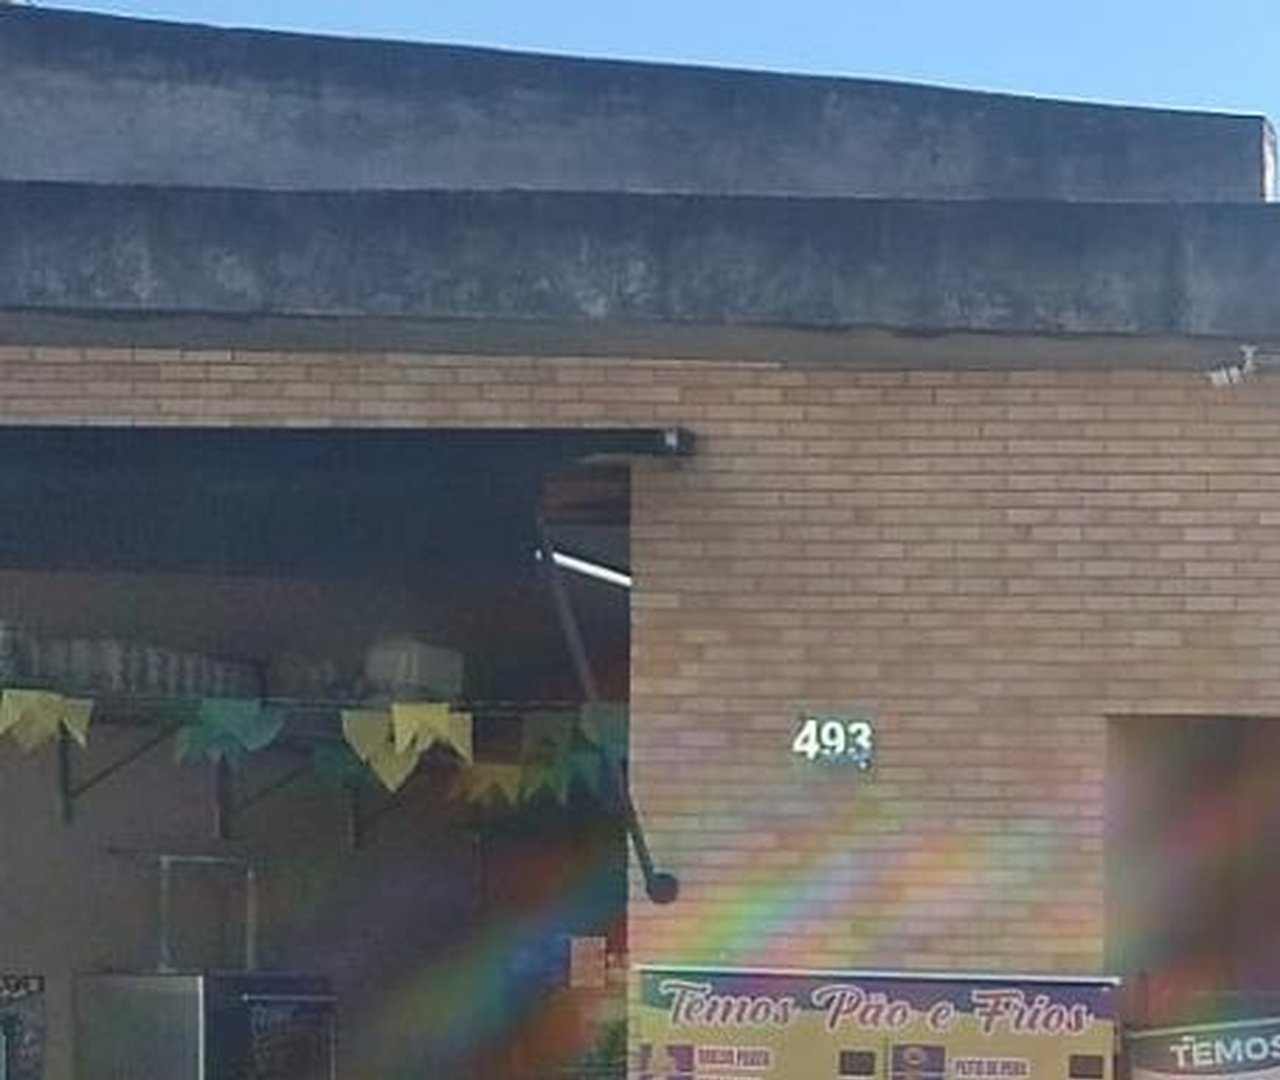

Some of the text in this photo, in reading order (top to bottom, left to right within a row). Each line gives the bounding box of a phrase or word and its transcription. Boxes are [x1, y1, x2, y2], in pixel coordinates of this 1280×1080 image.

[792, 720, 872, 759] 493
[661, 981, 1092, 1035] Temos Pão e Frios
